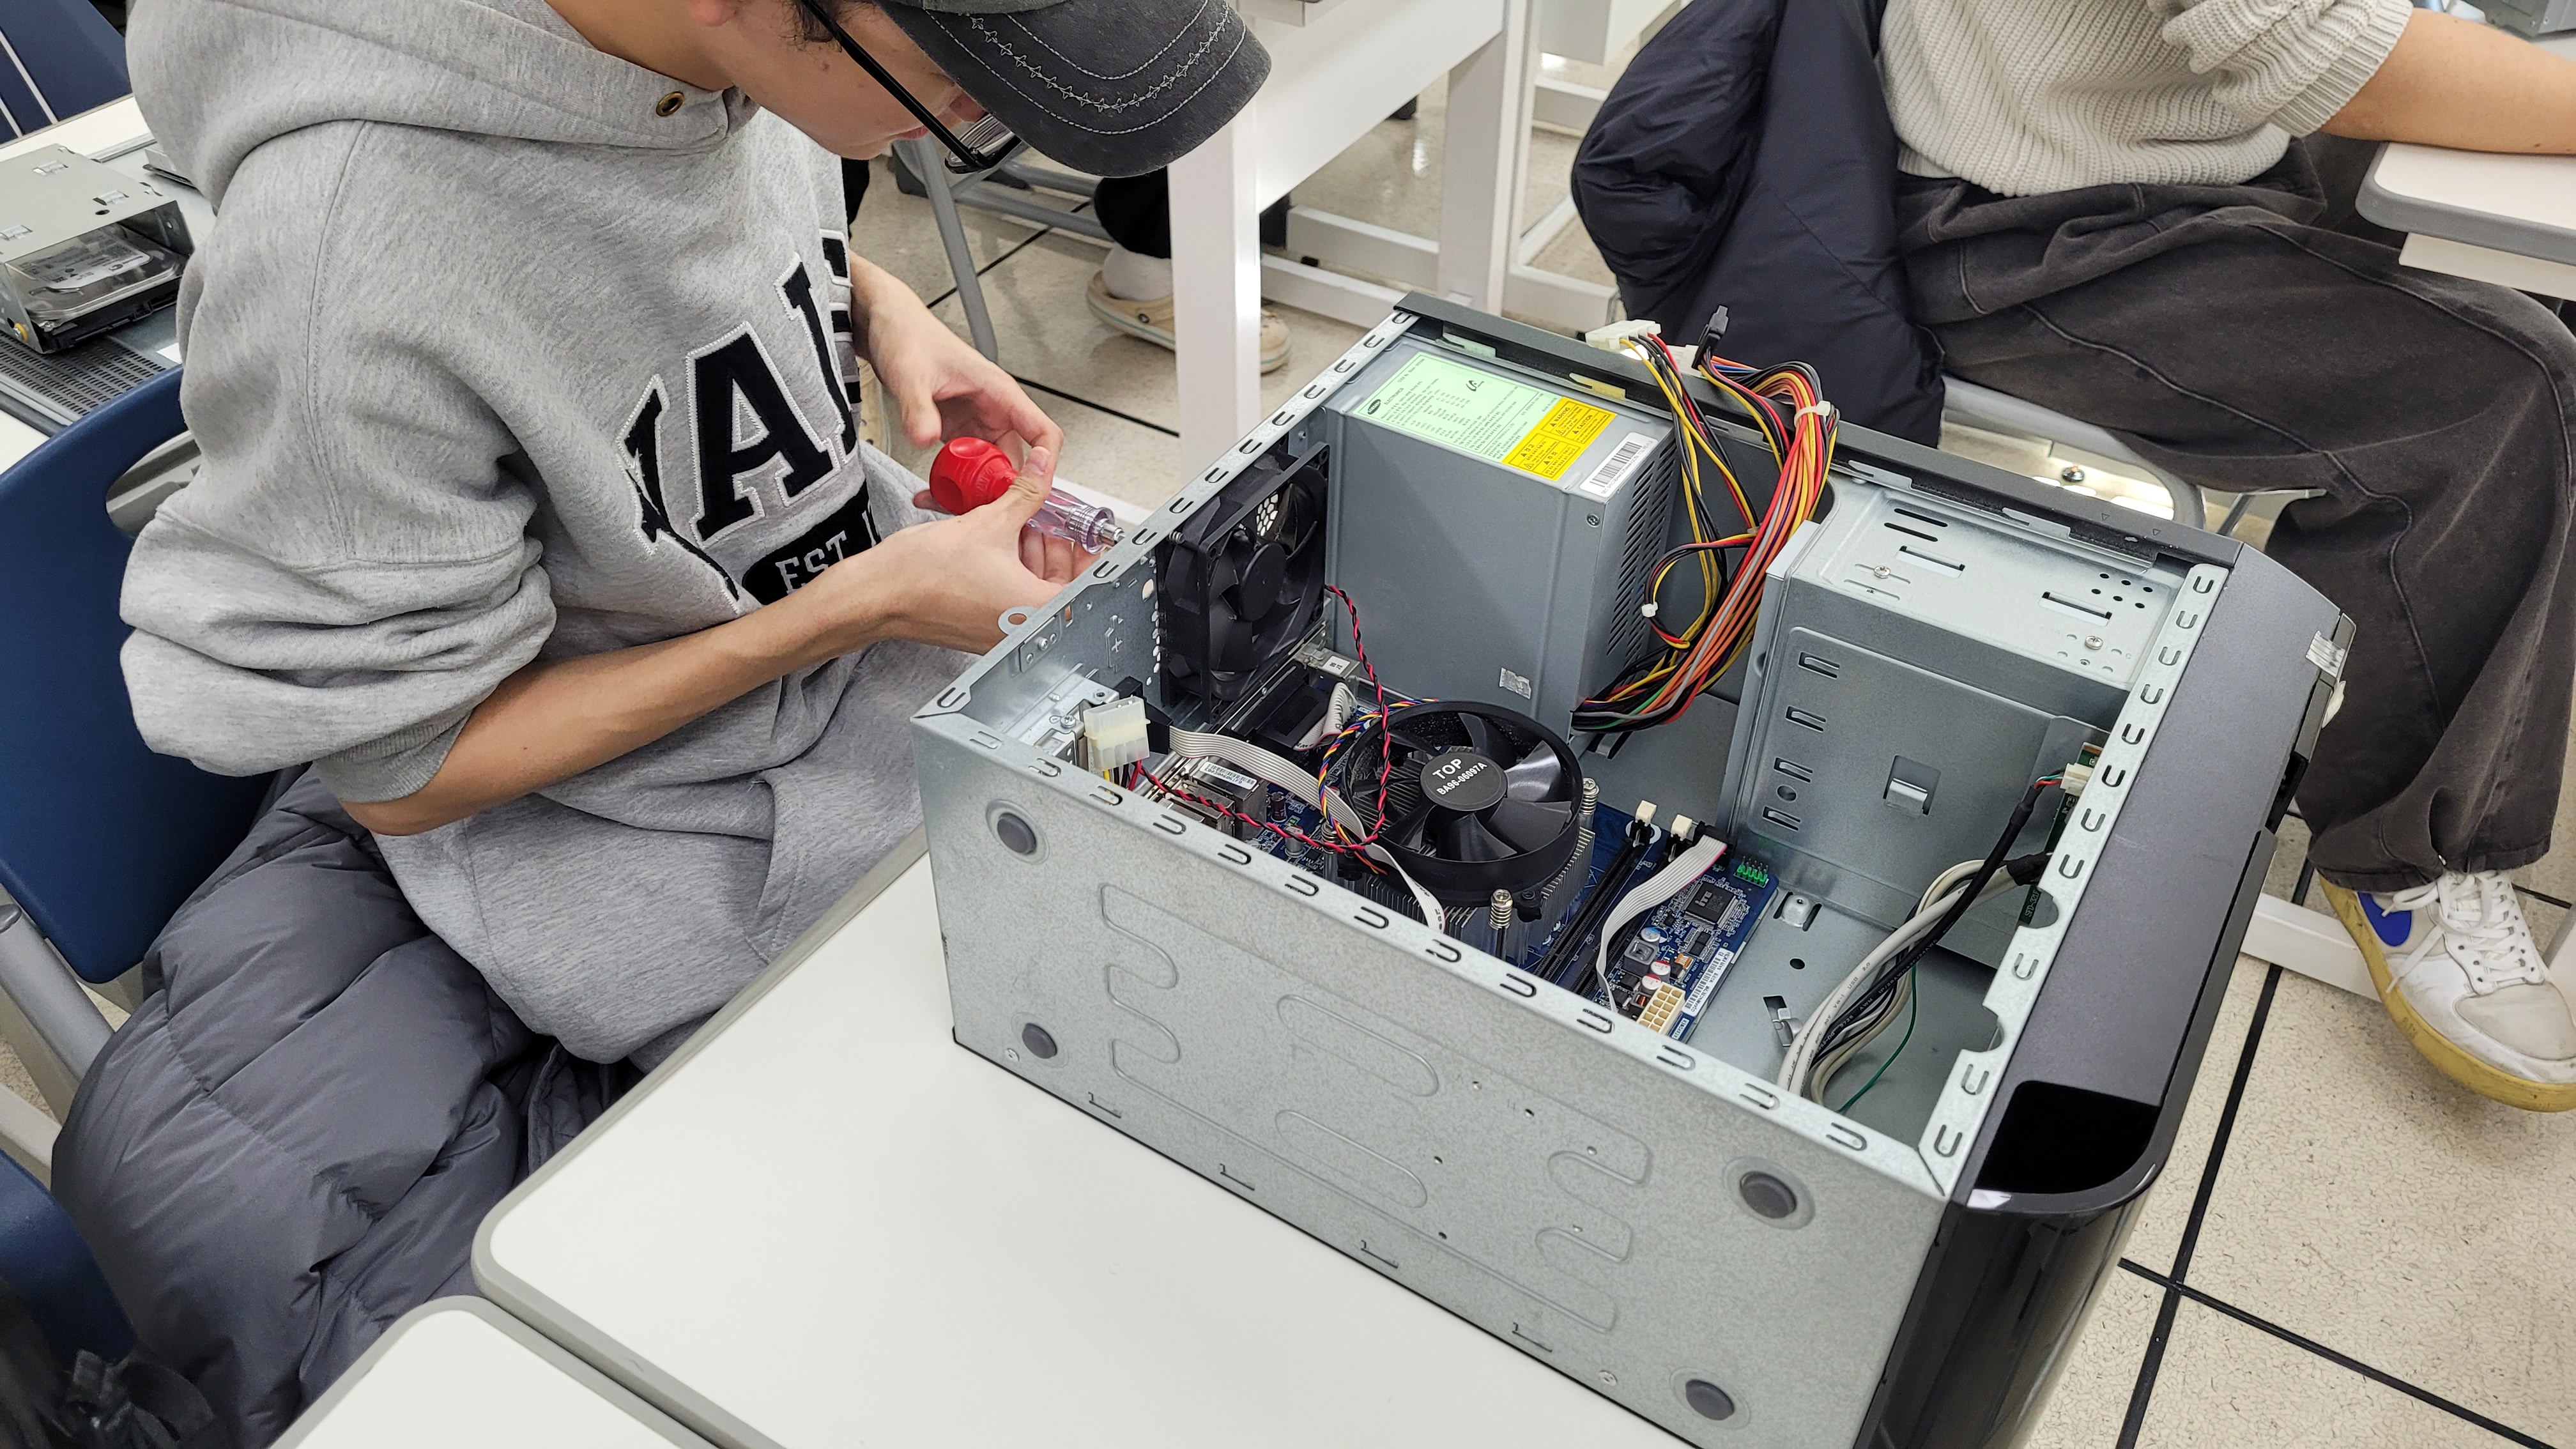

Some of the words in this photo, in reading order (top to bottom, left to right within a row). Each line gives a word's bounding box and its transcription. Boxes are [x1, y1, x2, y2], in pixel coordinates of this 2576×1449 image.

[1577, 414, 1593, 430] CAUTION
[1432, 758, 1462, 779] TOP
[1436, 762, 1487, 795] BA96-06097A
[1674, 1020, 1687, 1038] ATXPOWER
